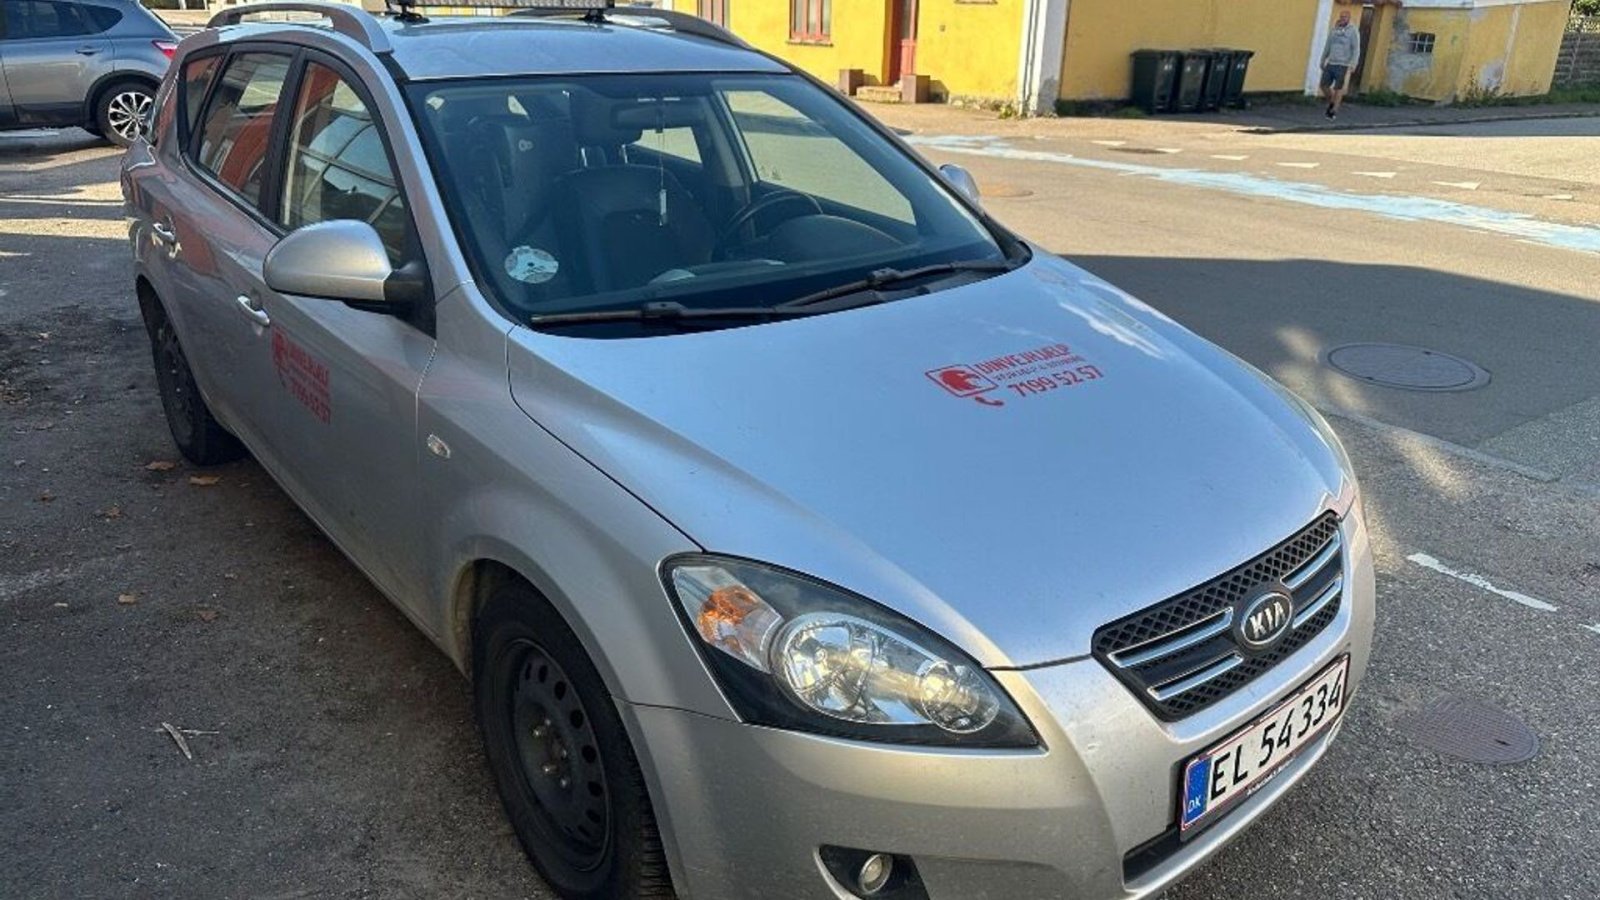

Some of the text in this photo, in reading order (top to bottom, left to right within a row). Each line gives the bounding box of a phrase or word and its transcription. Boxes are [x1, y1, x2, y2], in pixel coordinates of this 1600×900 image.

[1007, 364, 1104, 398] 7199 52 57
[1249, 601, 1287, 639] KIA
[1211, 744, 1248, 801] EL
[1258, 707, 1294, 769] 54
[1297, 669, 1343, 738] 334
[1187, 795, 1202, 814] DK
